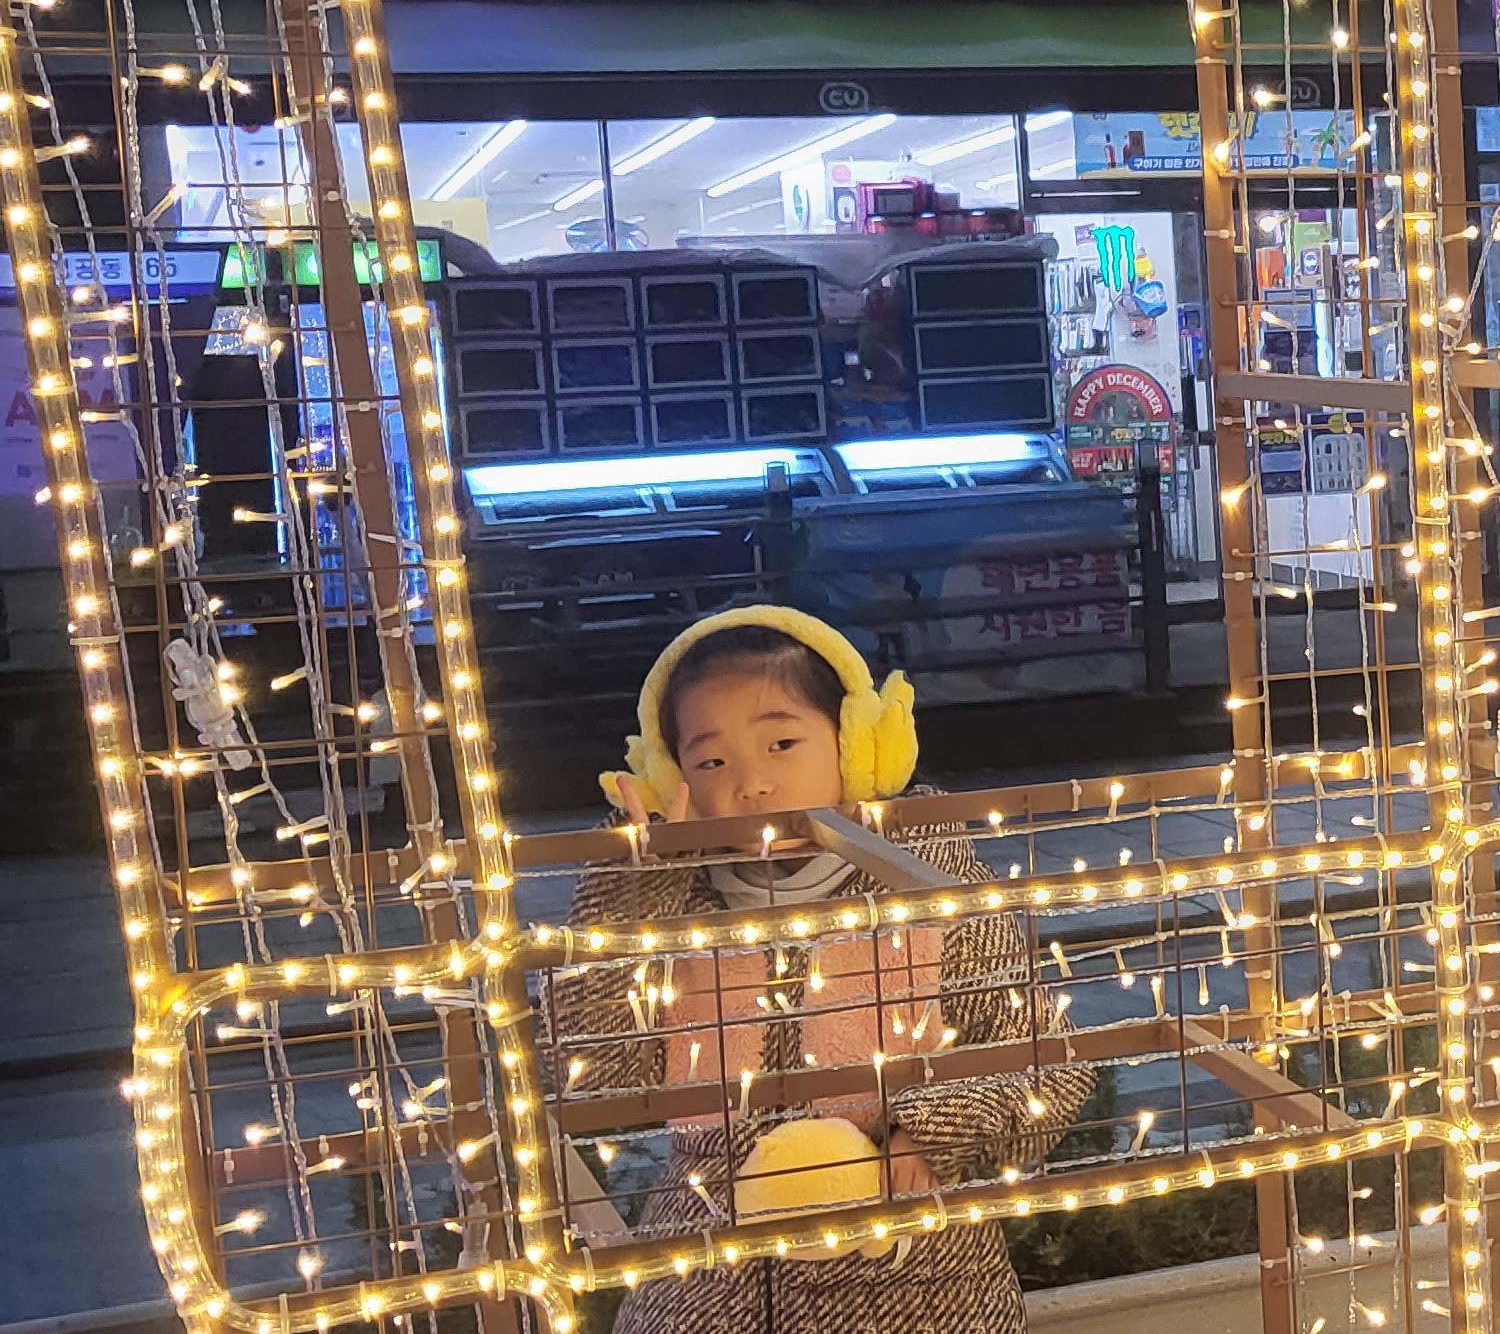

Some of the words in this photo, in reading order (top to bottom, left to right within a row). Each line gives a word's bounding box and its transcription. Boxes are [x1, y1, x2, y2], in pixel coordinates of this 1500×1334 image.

[829, 89, 859, 106] CU
[1073, 377, 1104, 418] HAPPY
[1107, 373, 1163, 415] DECEMBER
